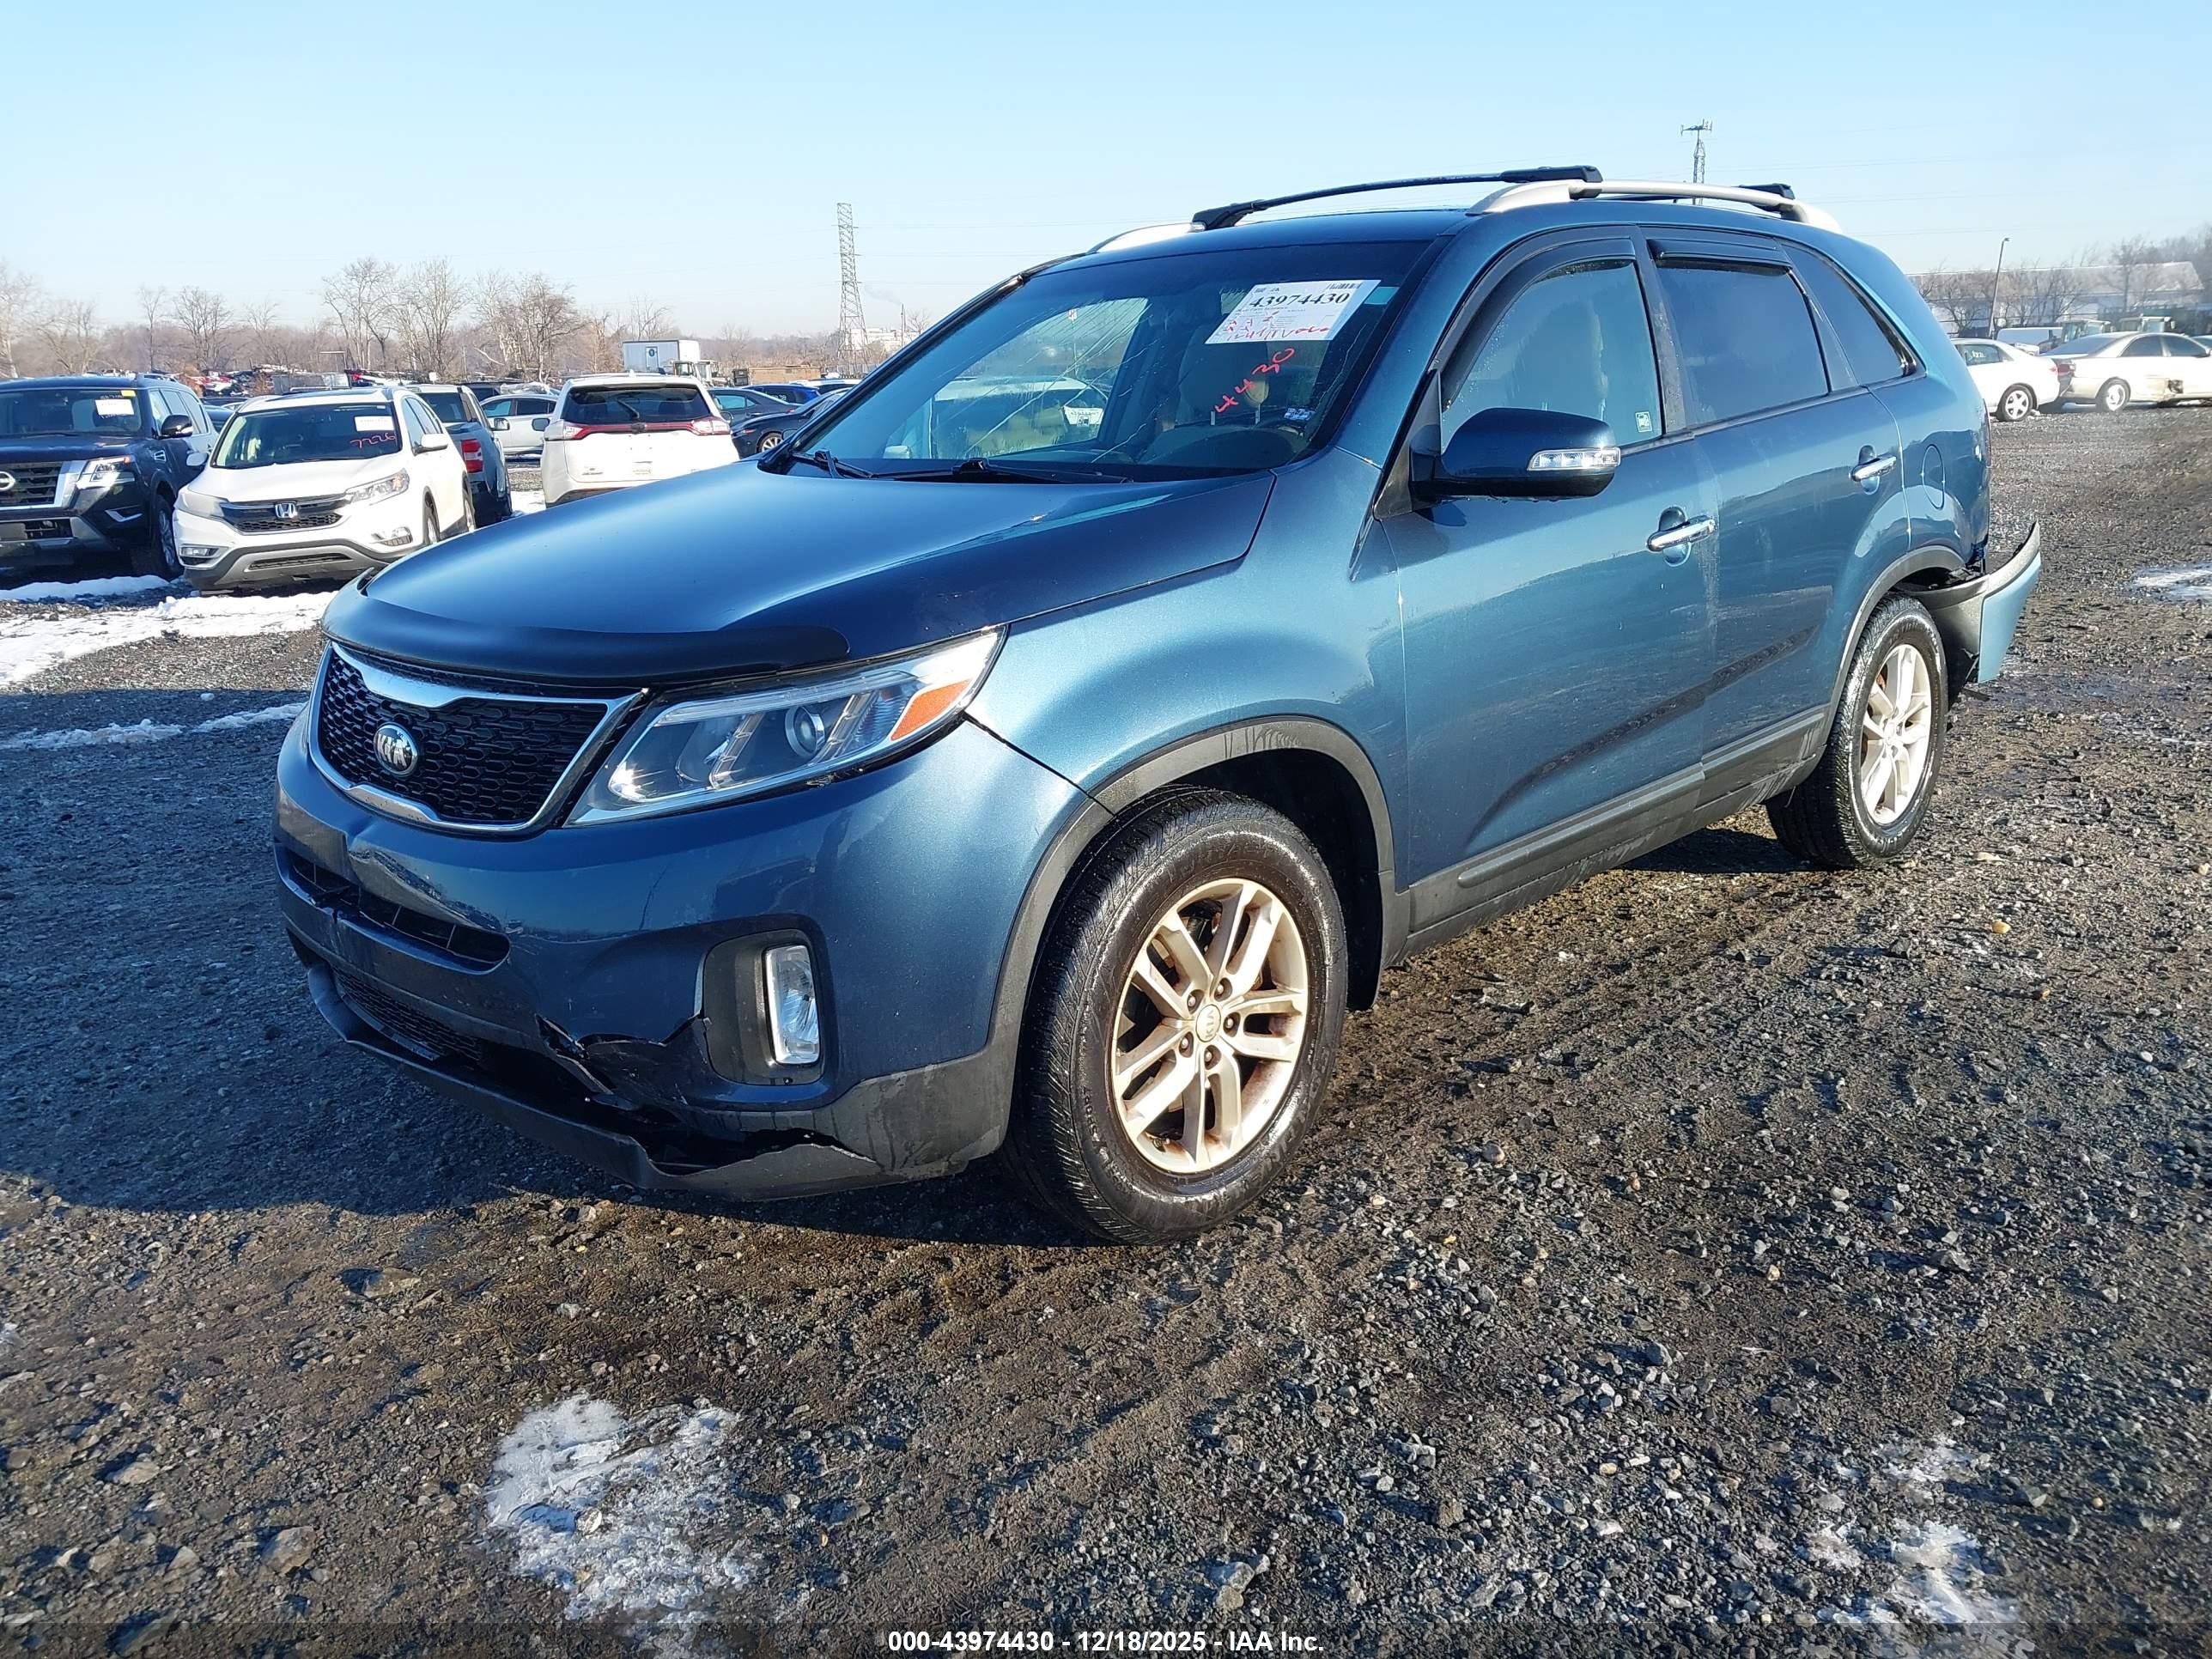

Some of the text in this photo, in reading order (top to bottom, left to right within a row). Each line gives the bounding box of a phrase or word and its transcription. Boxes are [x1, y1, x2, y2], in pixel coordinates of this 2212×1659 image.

[1249, 292, 1351, 307] 43974430
[1214, 347, 1296, 413] 4430
[377, 732, 408, 768] KIA
